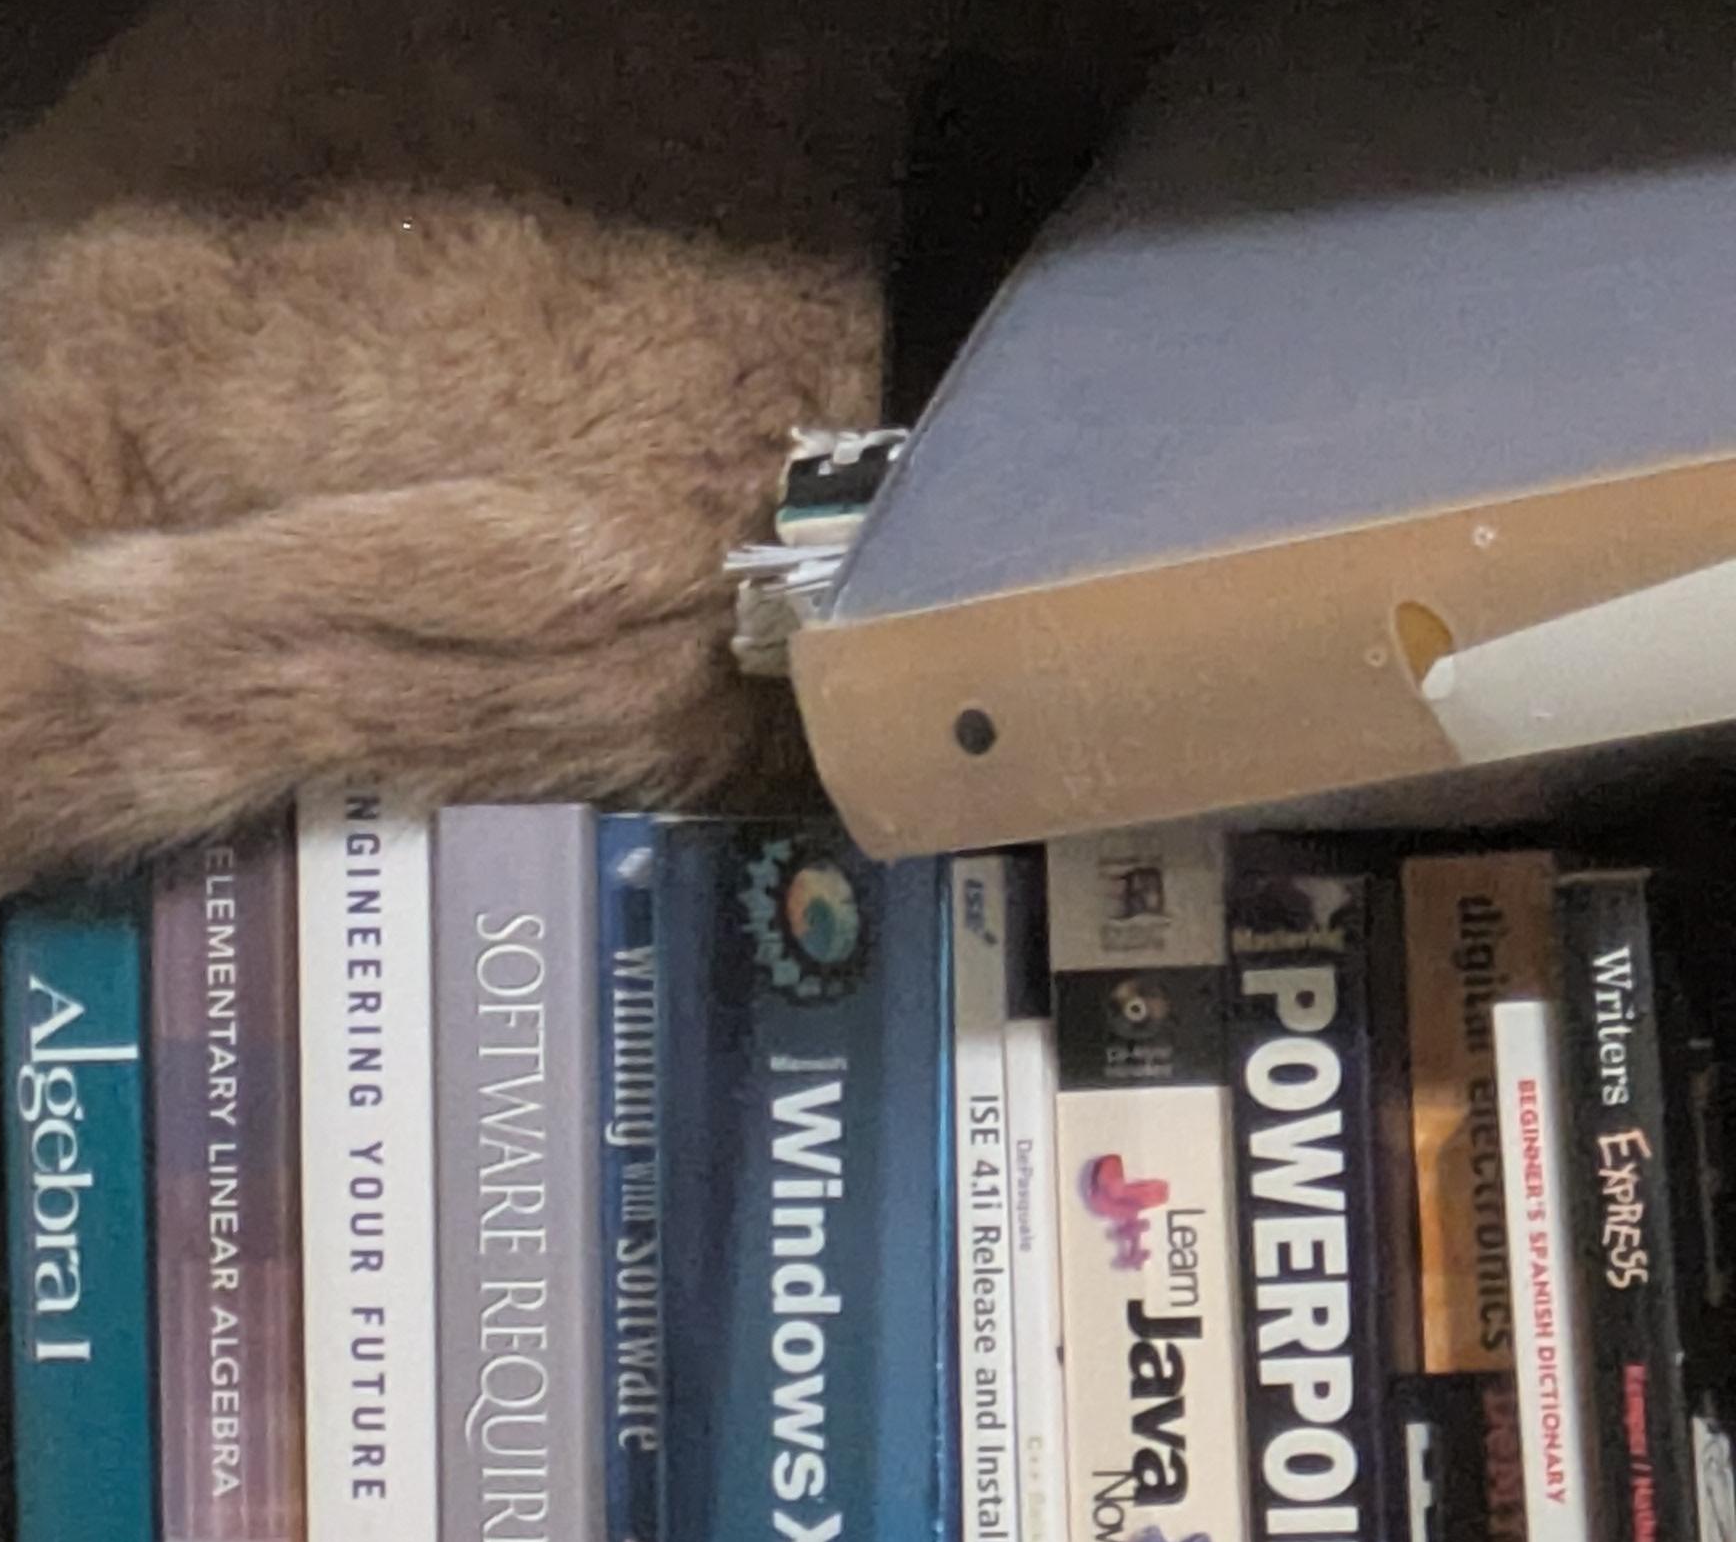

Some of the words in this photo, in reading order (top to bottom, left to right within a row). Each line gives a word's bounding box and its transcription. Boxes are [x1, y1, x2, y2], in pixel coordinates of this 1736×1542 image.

[206, 846, 238, 1128] ELEMENTARY
[1592, 947, 1632, 1107] Writers
[17, 975, 139, 1313] Algebra
[476, 913, 548, 1255] SOFTWARE
[969, 1094, 1000, 1146] ISE
[1517, 1079, 1547, 1221] BEGINNER'S
[207, 1144, 240, 1293] LINEAR
[348, 1140, 385, 1274] YOUR
[1166, 1208, 1205, 1308] Learn
[1529, 1230, 1554, 1340] SPANISH
[1598, 1127, 1653, 1290] EXPRESS
[770, 1080, 844, 1503] Windows
[972, 1222, 1005, 1355] Release
[209, 1305, 241, 1498] ALGEBRA
[350, 1306, 387, 1501] FUTURE
[975, 1371, 1007, 1431] and
[1126, 1297, 1203, 1507] Java
[1539, 1346, 1568, 1506] DICTIONARY
